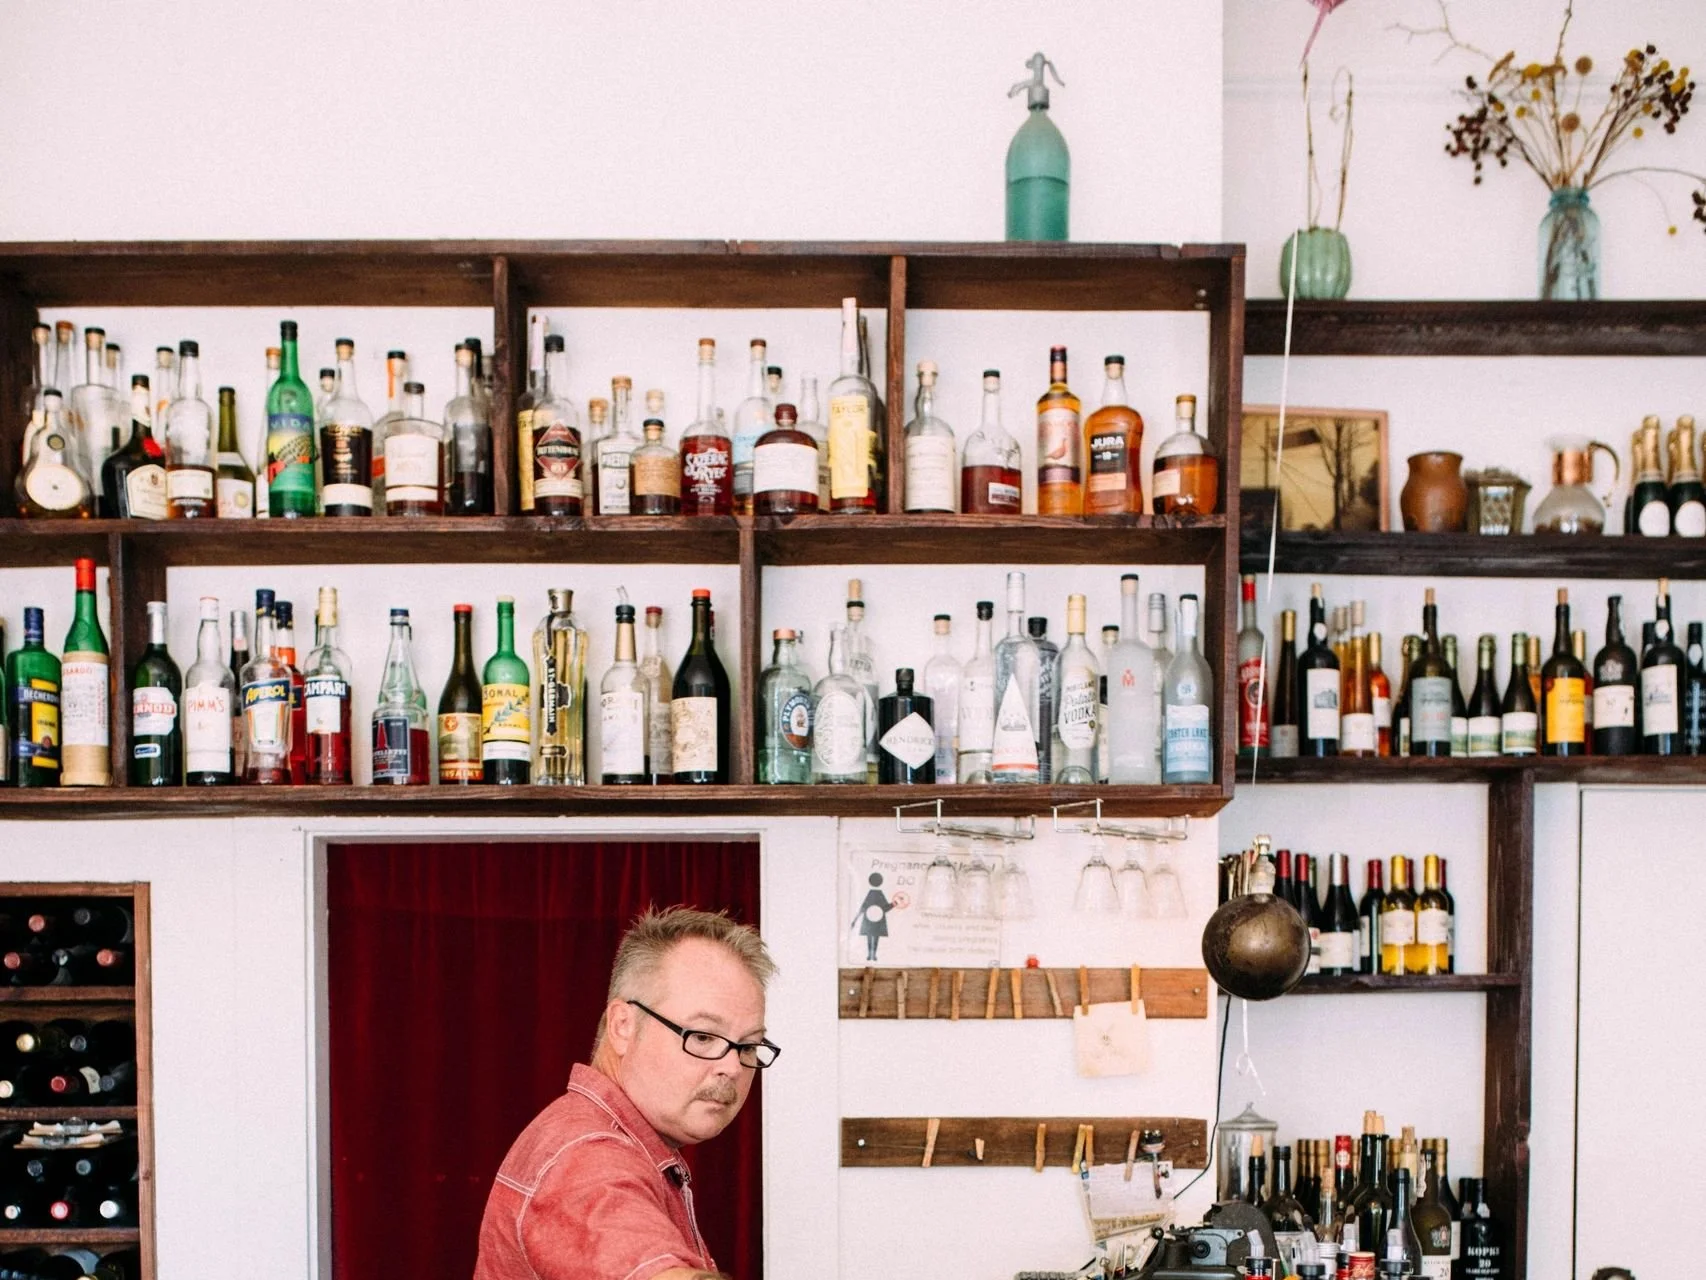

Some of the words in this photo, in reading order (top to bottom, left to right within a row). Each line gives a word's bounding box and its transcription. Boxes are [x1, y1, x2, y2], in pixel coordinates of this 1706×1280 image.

[1091, 436, 1124, 450] JURA
[245, 684, 287, 704] APEROL
[1063, 703, 1097, 724] VODKA
[870, 859, 929, 872] Pregnanc
